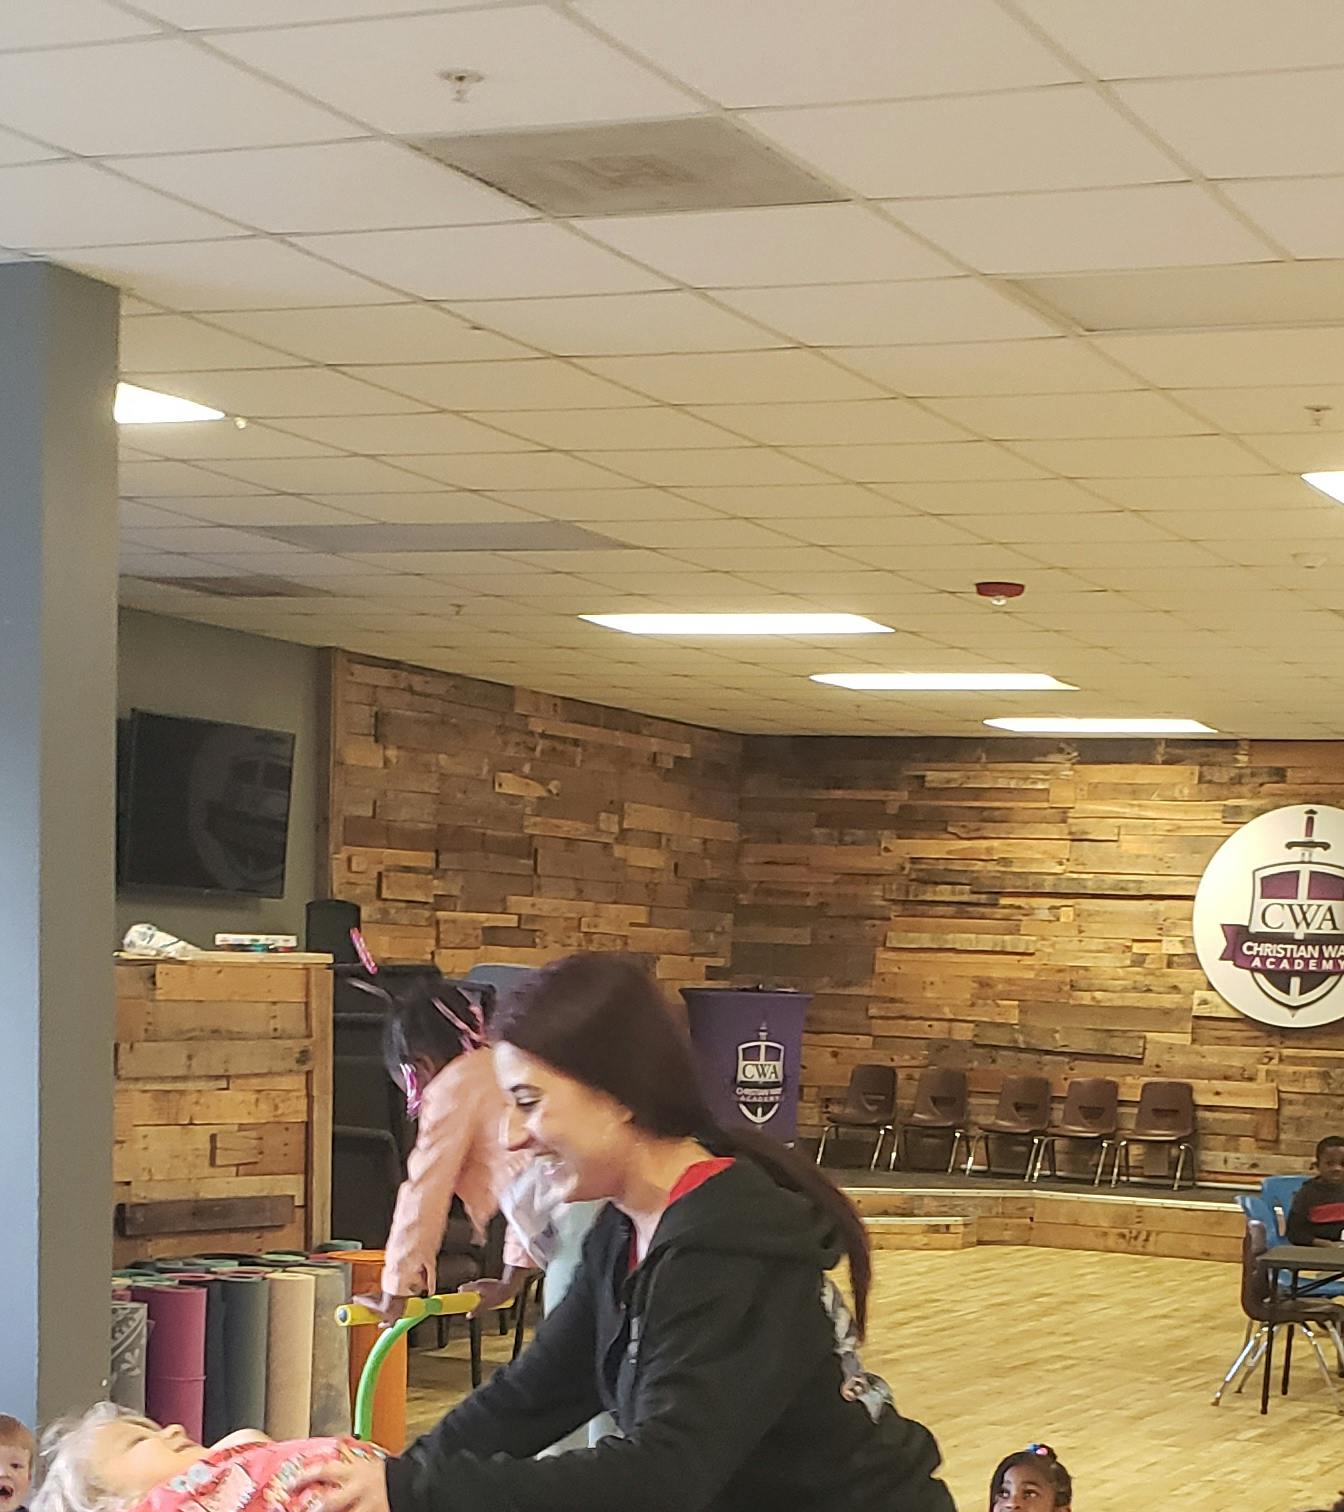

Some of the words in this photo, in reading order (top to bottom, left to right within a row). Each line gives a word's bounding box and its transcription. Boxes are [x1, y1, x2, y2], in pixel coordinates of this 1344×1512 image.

[1261, 902, 1341, 931] CWA
[1241, 942, 1320, 958] CHRISTIAN
[742, 1063, 779, 1080] CWA
